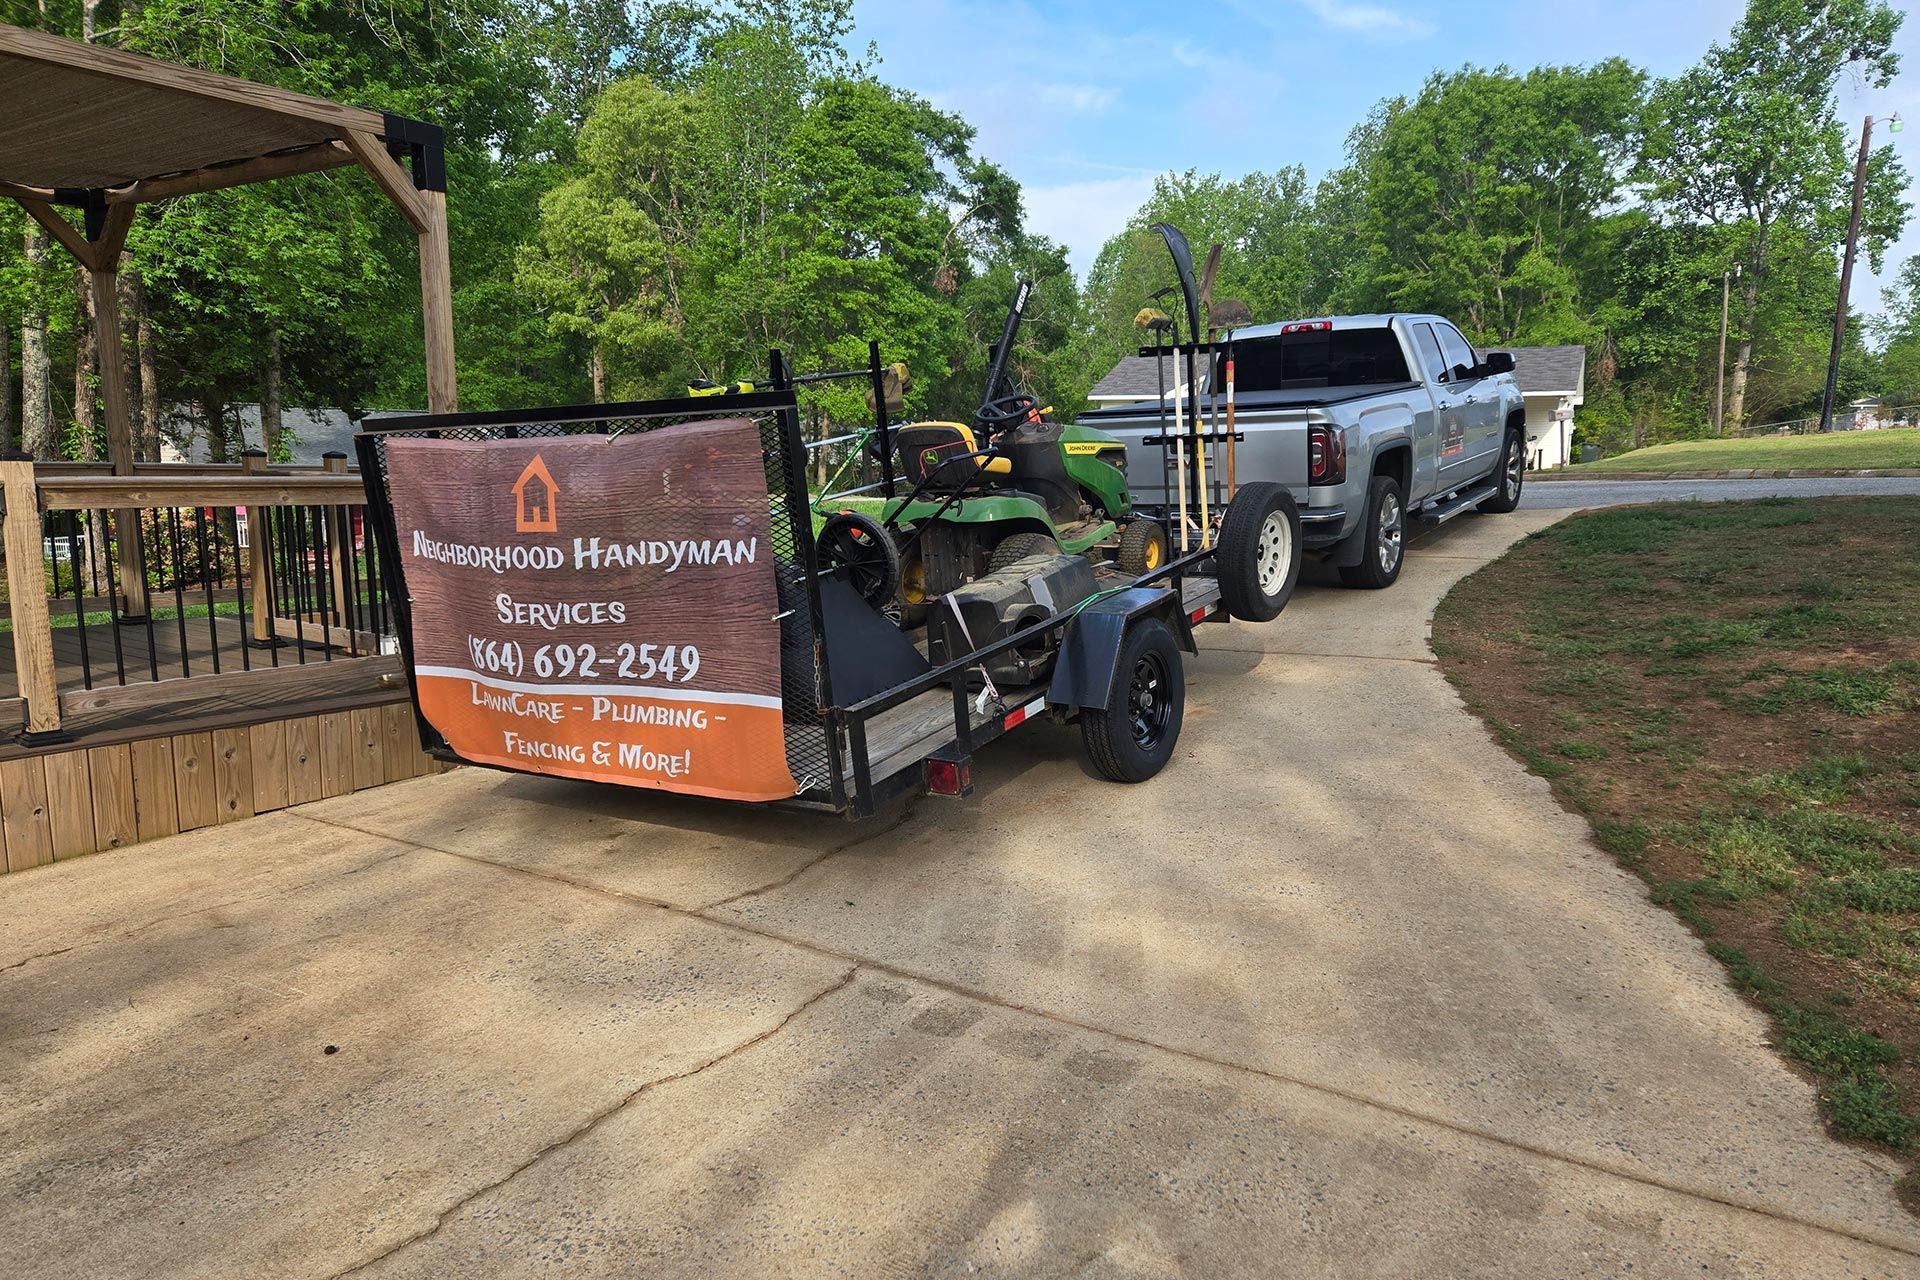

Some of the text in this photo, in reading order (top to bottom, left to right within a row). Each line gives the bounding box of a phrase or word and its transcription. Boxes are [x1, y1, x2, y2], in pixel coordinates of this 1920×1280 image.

[413, 530, 757, 574] NEIGHBORHOOD HANDYMAN
[495, 593, 626, 630] SERVICES
[469, 634, 700, 682] (864) 692-2549
[592, 697, 707, 730] PLUMBING
[504, 731, 586, 764] FENCING
[592, 741, 613, 767] &
